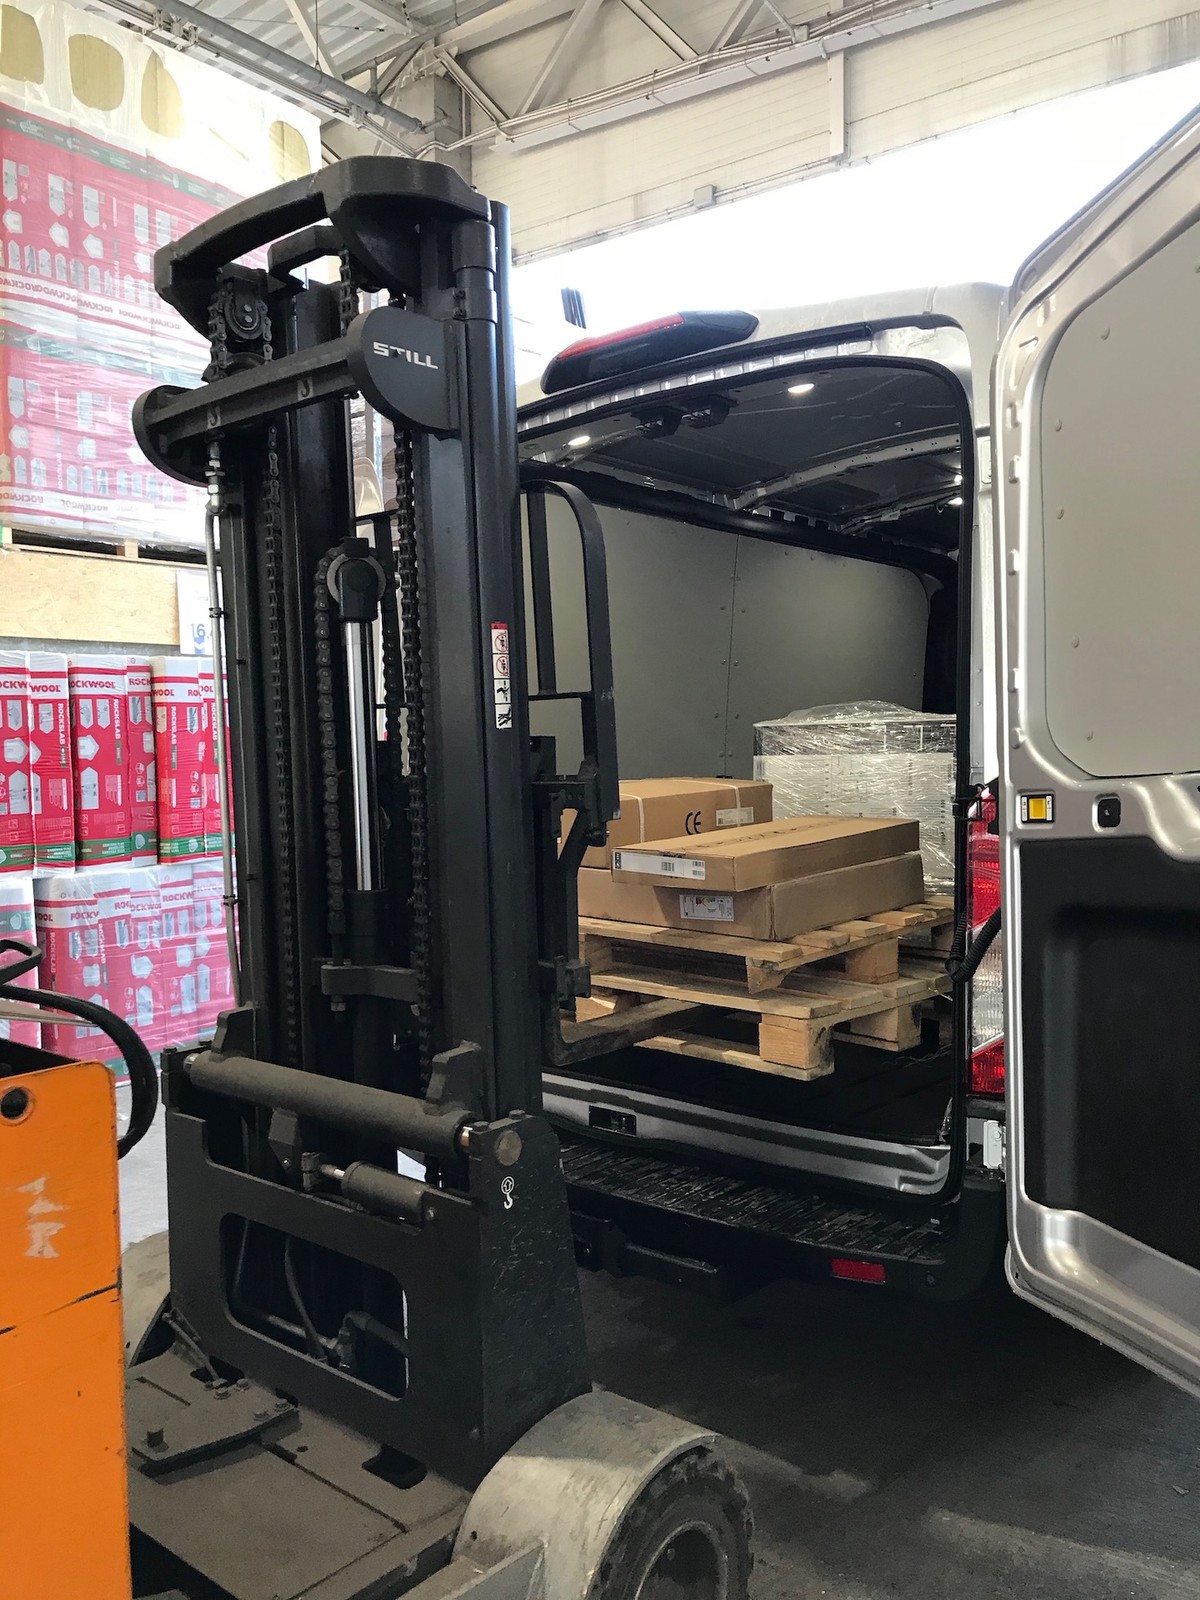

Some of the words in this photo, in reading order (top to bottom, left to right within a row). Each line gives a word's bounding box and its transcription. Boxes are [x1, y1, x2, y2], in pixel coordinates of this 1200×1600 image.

[373, 341, 438, 369] STILL
[57, 703, 66, 745] ROCKSLAB
[113, 698, 121, 740] ROCKSLAB
